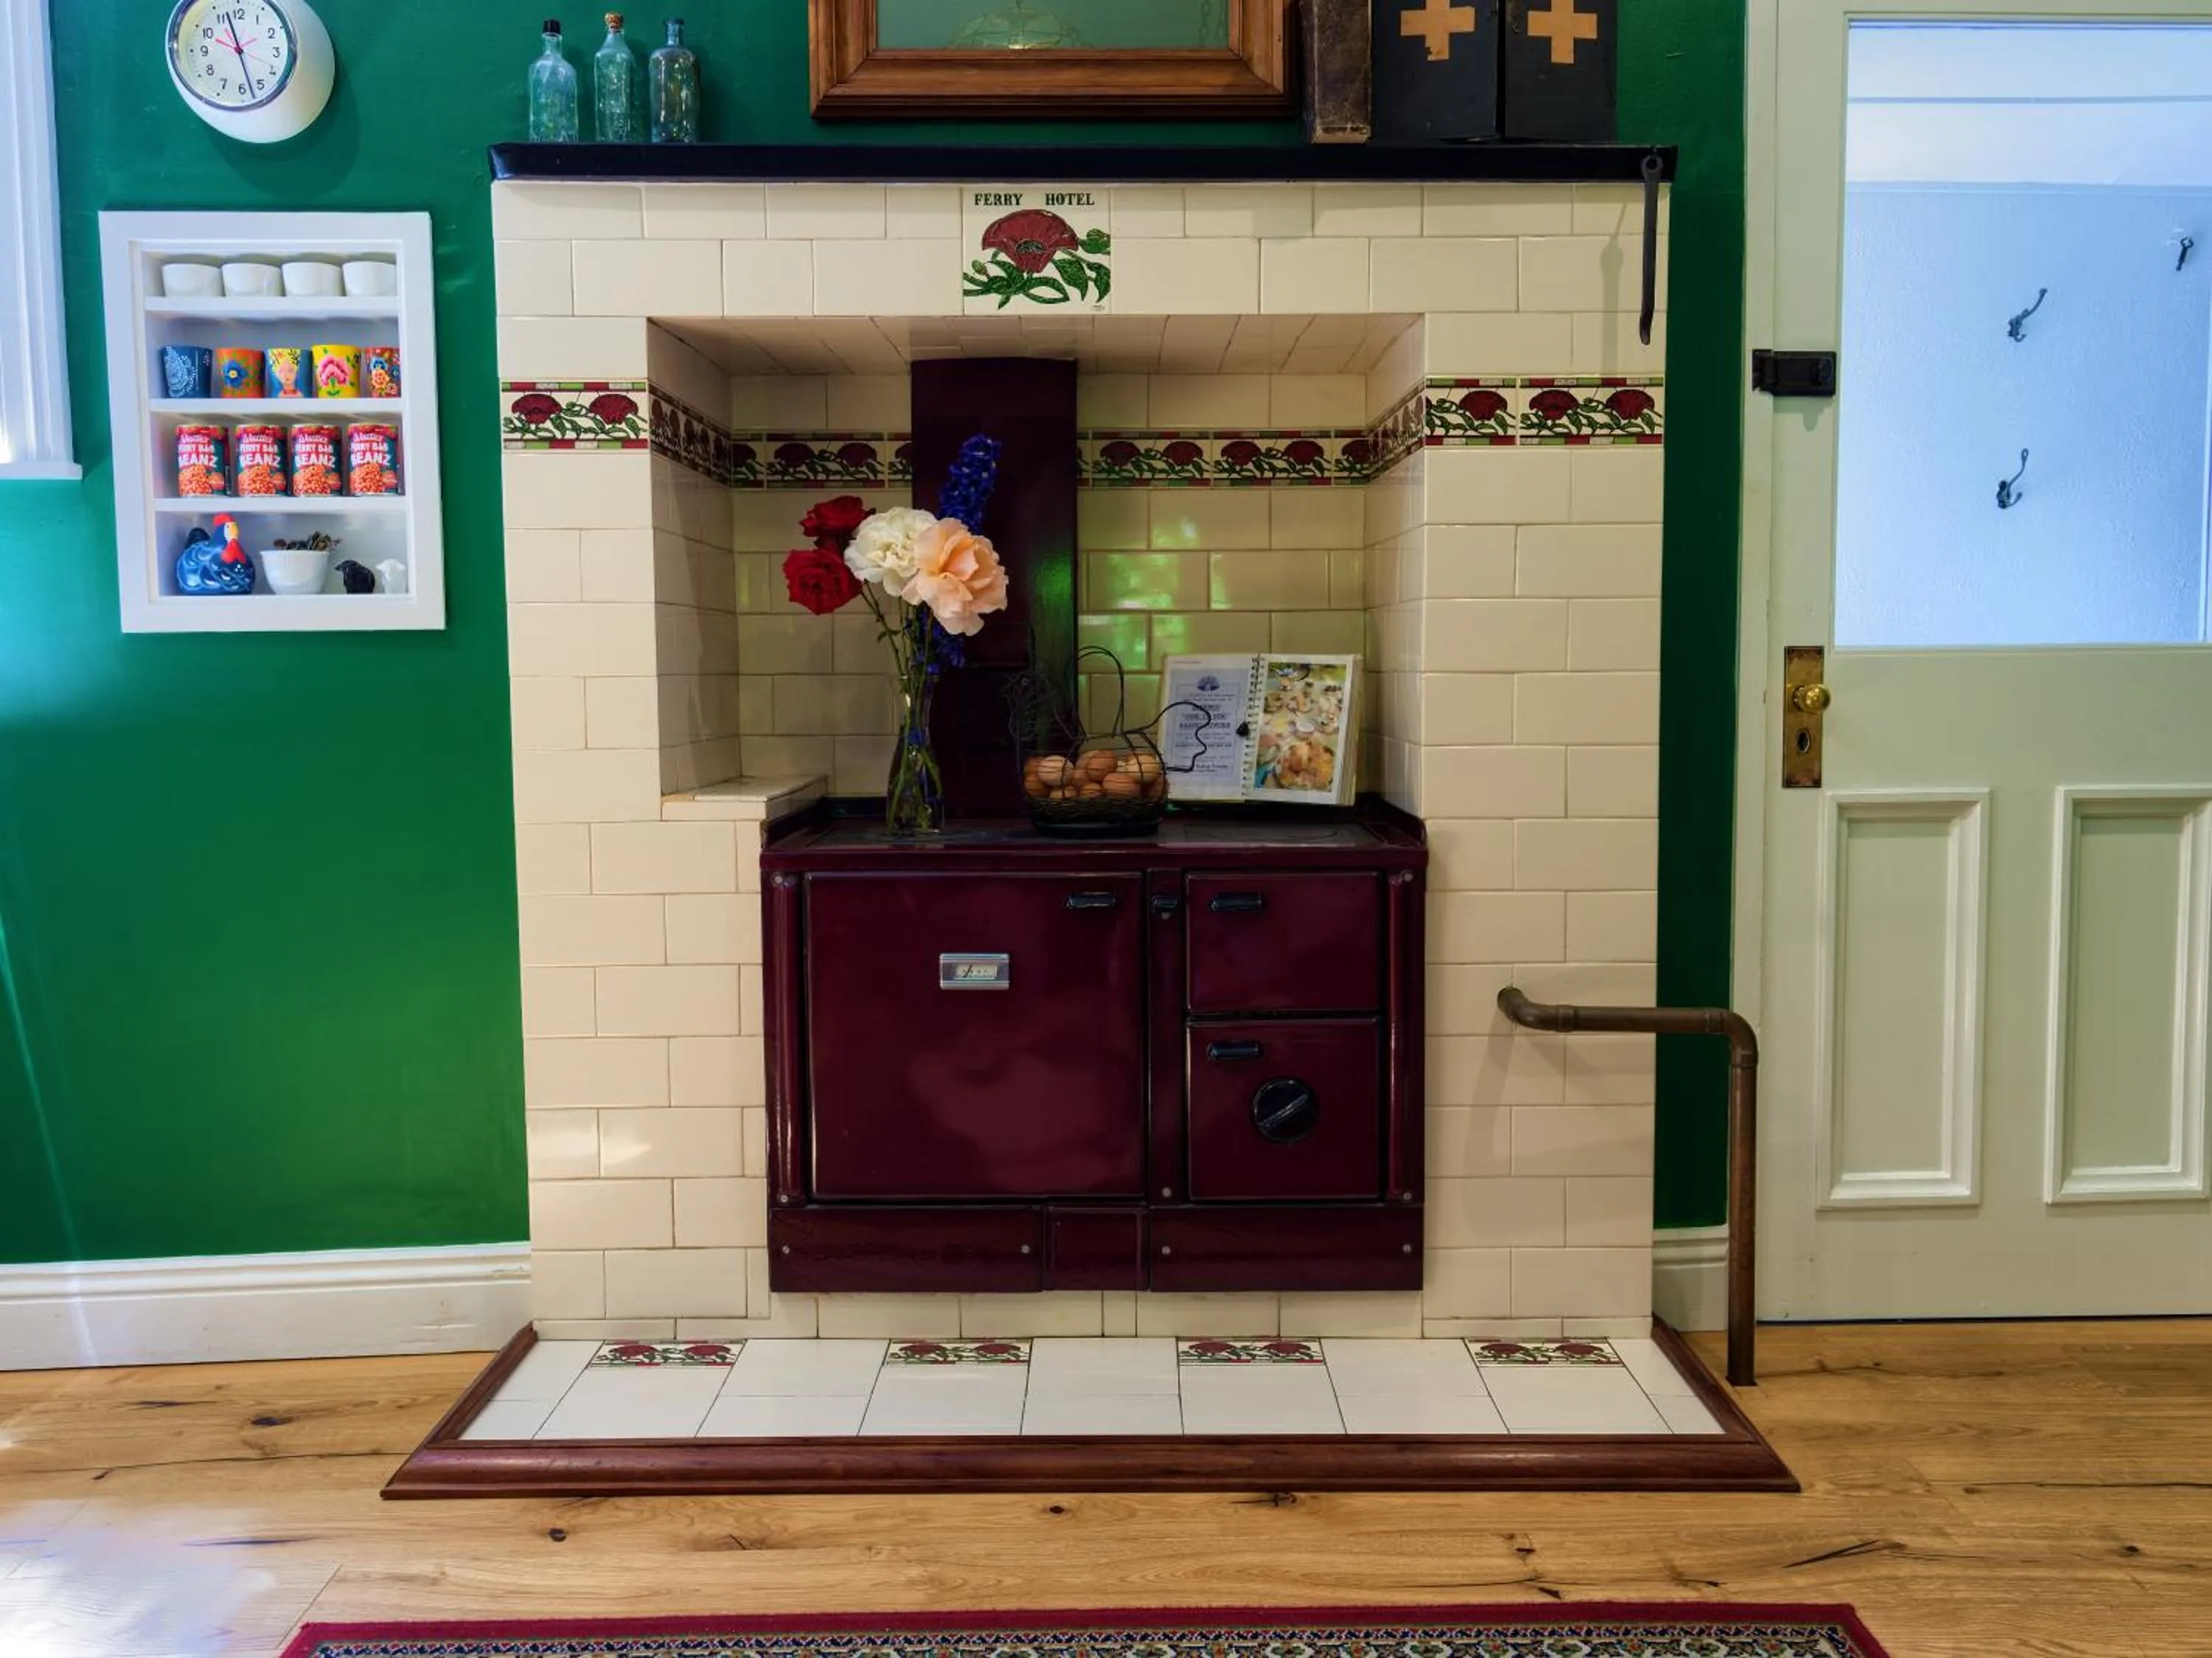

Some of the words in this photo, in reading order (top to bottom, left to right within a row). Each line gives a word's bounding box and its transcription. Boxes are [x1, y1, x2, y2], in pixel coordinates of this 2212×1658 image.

[217, 14, 225, 24] 11
[233, 8, 246, 20] 12
[203, 27, 214, 39] 10
[268, 27, 276, 39] 2
[201, 46, 209, 57] 9
[272, 46, 280, 58] 3
[206, 64, 215, 76] 8
[220, 78, 228, 90] 7
[238, 83, 247, 95] 6
[257, 79, 265, 91] 5
[974, 192, 1023, 206] FERRY
[1045, 192, 1095, 206] HOTEL
[178, 453, 218, 468] BEANZ
[239, 453, 280, 468] BEANZ
[295, 454, 335, 468] BEANZ
[351, 451, 392, 466] BEANZ
